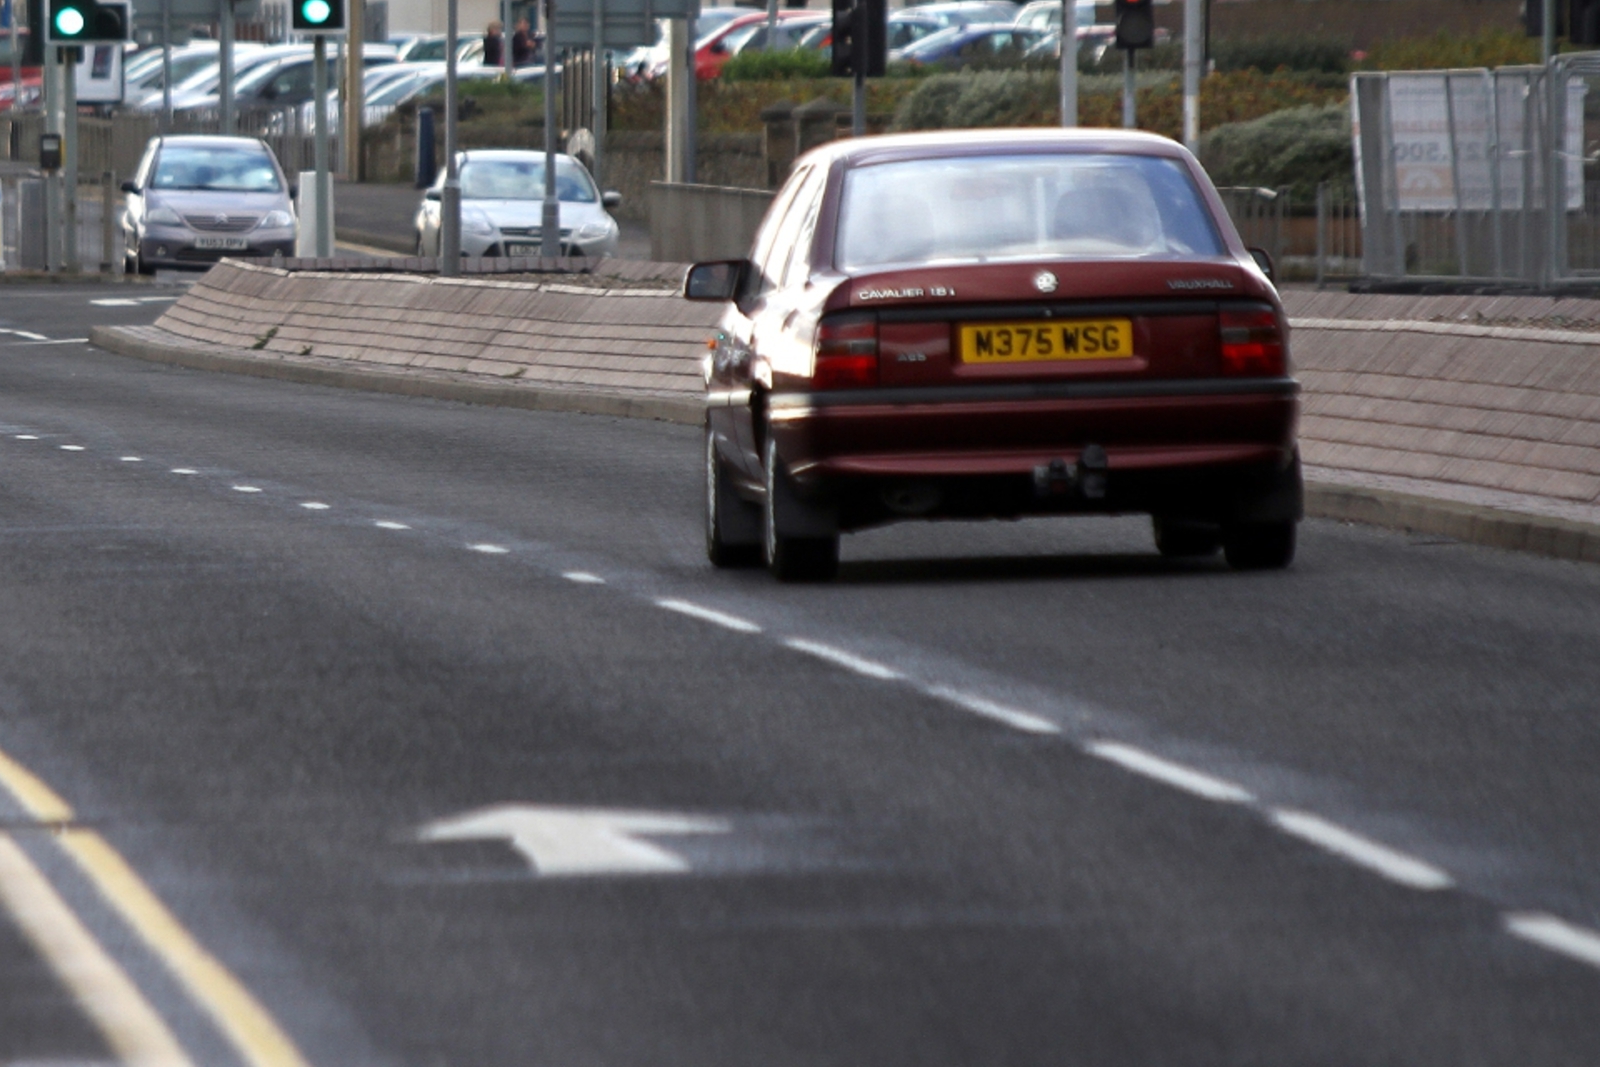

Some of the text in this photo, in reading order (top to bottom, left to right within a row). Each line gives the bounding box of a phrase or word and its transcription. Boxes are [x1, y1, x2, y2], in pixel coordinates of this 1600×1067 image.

[1166, 278, 1234, 290] VAUXHALL
[859, 288, 925, 301] CAVALIER
[975, 325, 1120, 357] M375 WSG
